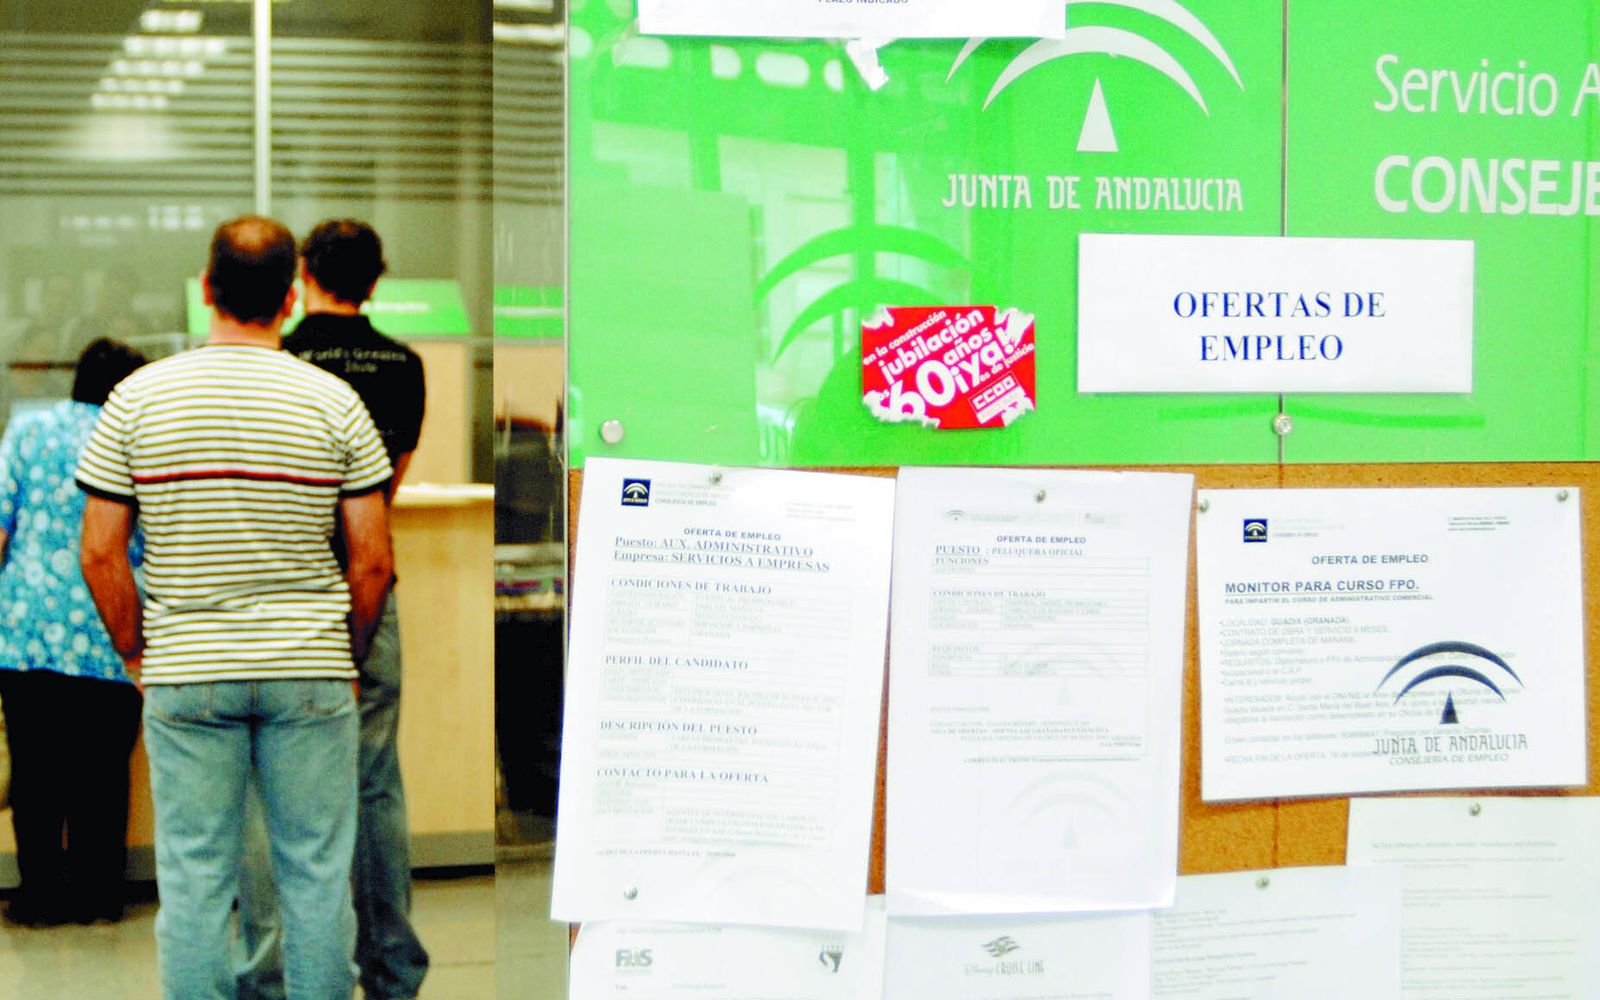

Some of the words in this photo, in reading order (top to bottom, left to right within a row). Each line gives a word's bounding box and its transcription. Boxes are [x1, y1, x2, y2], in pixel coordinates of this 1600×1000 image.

[1374, 54, 1558, 117] Servicio
[942, 173, 1032, 209] JUNTA
[1047, 175, 1081, 209] DE
[1095, 176, 1244, 211] ANDALUCIA
[1173, 291, 1331, 318] OFERTAS
[1343, 291, 1386, 318] DE
[862, 352, 876, 365] en
[875, 346, 888, 357] la
[888, 310, 946, 350] construcción
[878, 309, 984, 385] jubilación
[943, 326, 993, 366] años
[1200, 334, 1344, 361] EMPLEO
[991, 362, 1004, 374] de
[684, 528, 721, 537] OFERTA
[725, 530, 738, 538] DE
[741, 531, 781, 541] EMPLEO
[997, 534, 1032, 543] OFERTA
[1035, 535, 1049, 544] DE
[1050, 535, 1087, 544] EMPLEO
[615, 536, 657, 548] Puesto:
[660, 538, 690, 550] AUX.
[695, 541, 814, 557] ADMINISTRATIVO
[935, 545, 980, 556] PUESTO
[991, 547, 1047, 558] PELUQUERA
[1047, 548, 1084, 557] OFICIAL
[613, 550, 669, 563] Empresa:
[671, 552, 743, 566] SERVICIOS
[745, 556, 755, 566] A
[758, 557, 830, 572] EMPRESAS
[935, 557, 990, 566] FUNCIONES
[1312, 555, 1358, 565] OFERTA
[1362, 555, 1377, 564] DE
[1381, 554, 1429, 564] EMPLEO
[611, 577, 692, 589] CONDICIONES
[695, 580, 709, 590] DE
[714, 582, 772, 595] TRABAJO
[1225, 582, 1290, 593] MONITOR
[1295, 581, 1332, 592] PARA
[1336, 580, 1385, 591] CURSO
[1389, 579, 1420, 590] FPO.
[932, 590, 992, 598] CONDICIONES
[993, 590, 1005, 598] DE
[1007, 591, 1047, 599] TRABAJO
[1330, 595, 1390, 603] ADMINISTRATIVO
[1270, 617, 1302, 625] GUADIX
[605, 655, 645, 665] PERFIL
[648, 656, 671, 666] DEL
[675, 657, 748, 670] CANDIDATO
[682, 722, 707, 733] DEL
[710, 723, 758, 735] PUESTO
[1372, 737, 1417, 755] JUNTA
[1425, 736, 1442, 752] DE
[1449, 733, 1528, 752] ANDALUCIA
[1451, 754, 1465, 764] DE
[1468, 752, 1510, 763] EMPLEO
[596, 767, 663, 778] CONTACTO
[665, 769, 696, 779] PARA
[700, 770, 716, 781] LA
[719, 772, 769, 783] OFERTA
[995, 960, 1025, 976] CRUISE
[1027, 960, 1046, 976] LINE
